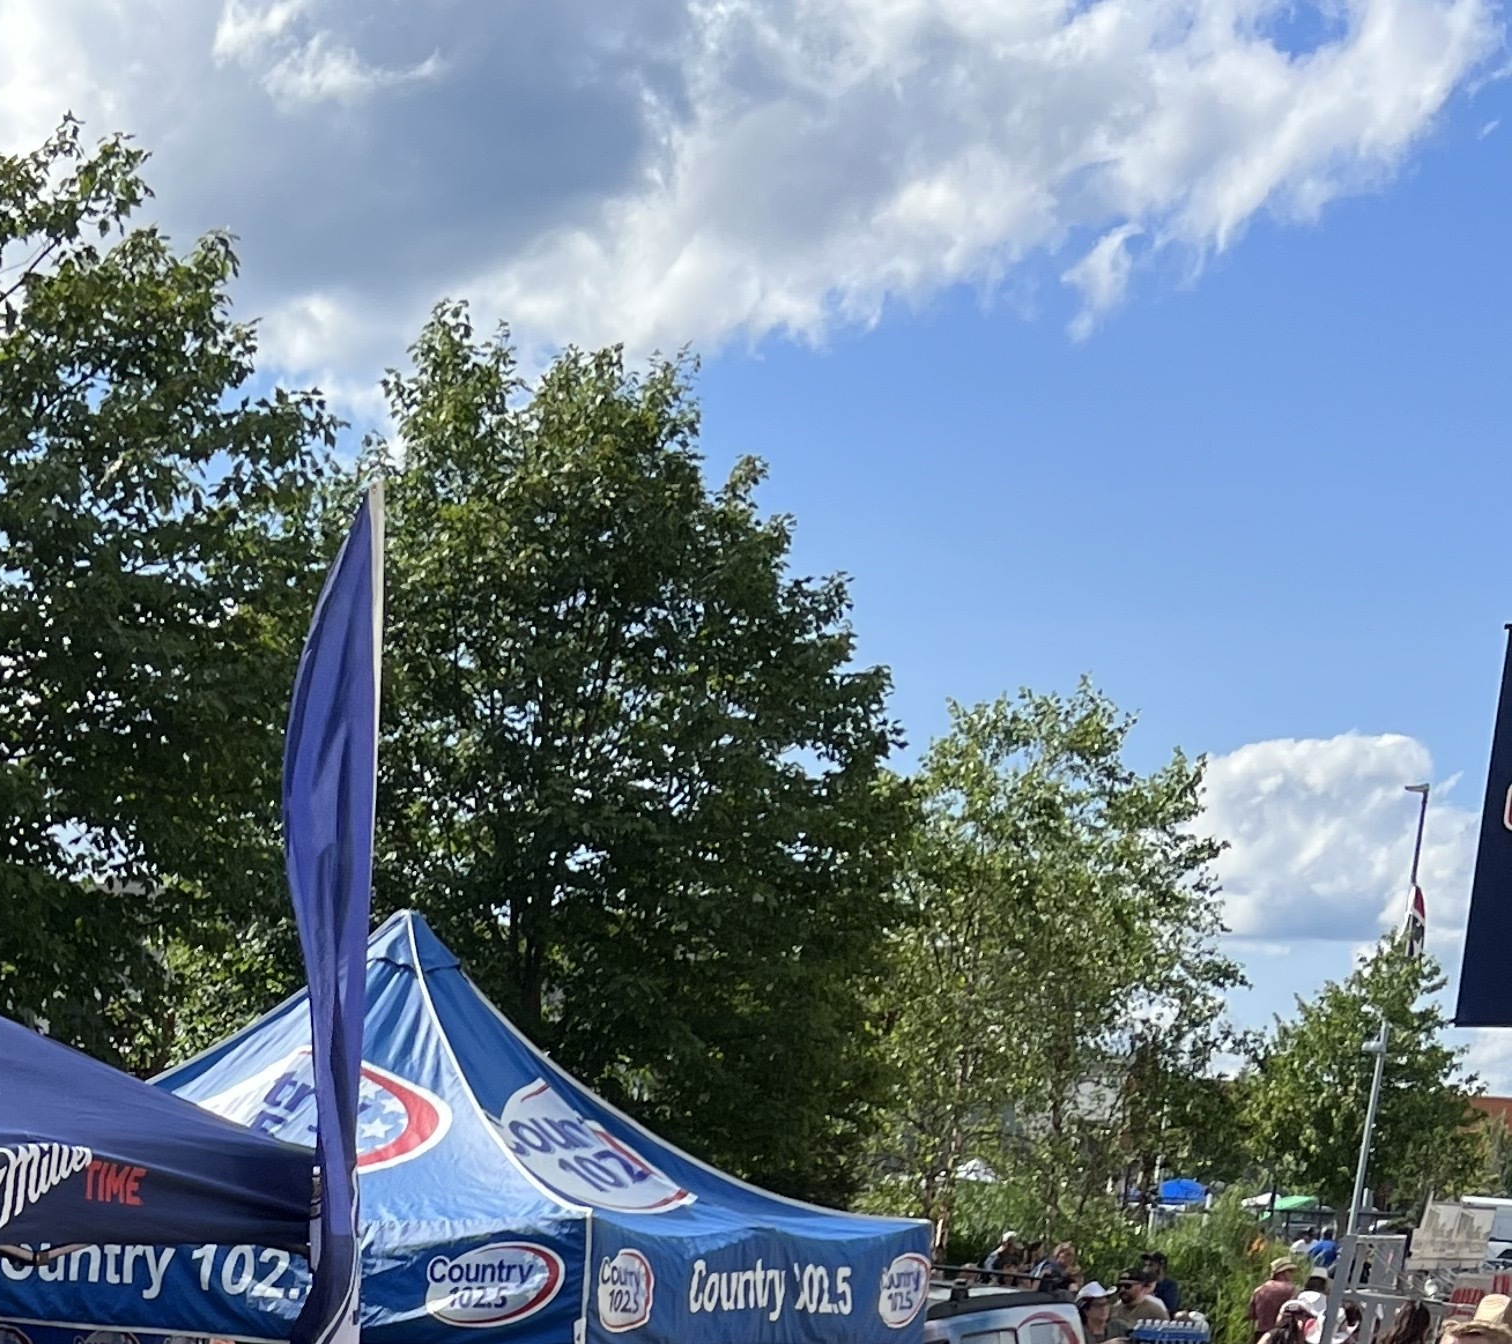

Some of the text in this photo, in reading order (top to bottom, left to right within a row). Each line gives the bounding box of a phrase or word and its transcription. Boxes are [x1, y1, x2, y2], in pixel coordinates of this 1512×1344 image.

[85, 1161, 147, 1206] TIME
[429, 1259, 533, 1284] Country
[690, 1259, 786, 1321] Country
